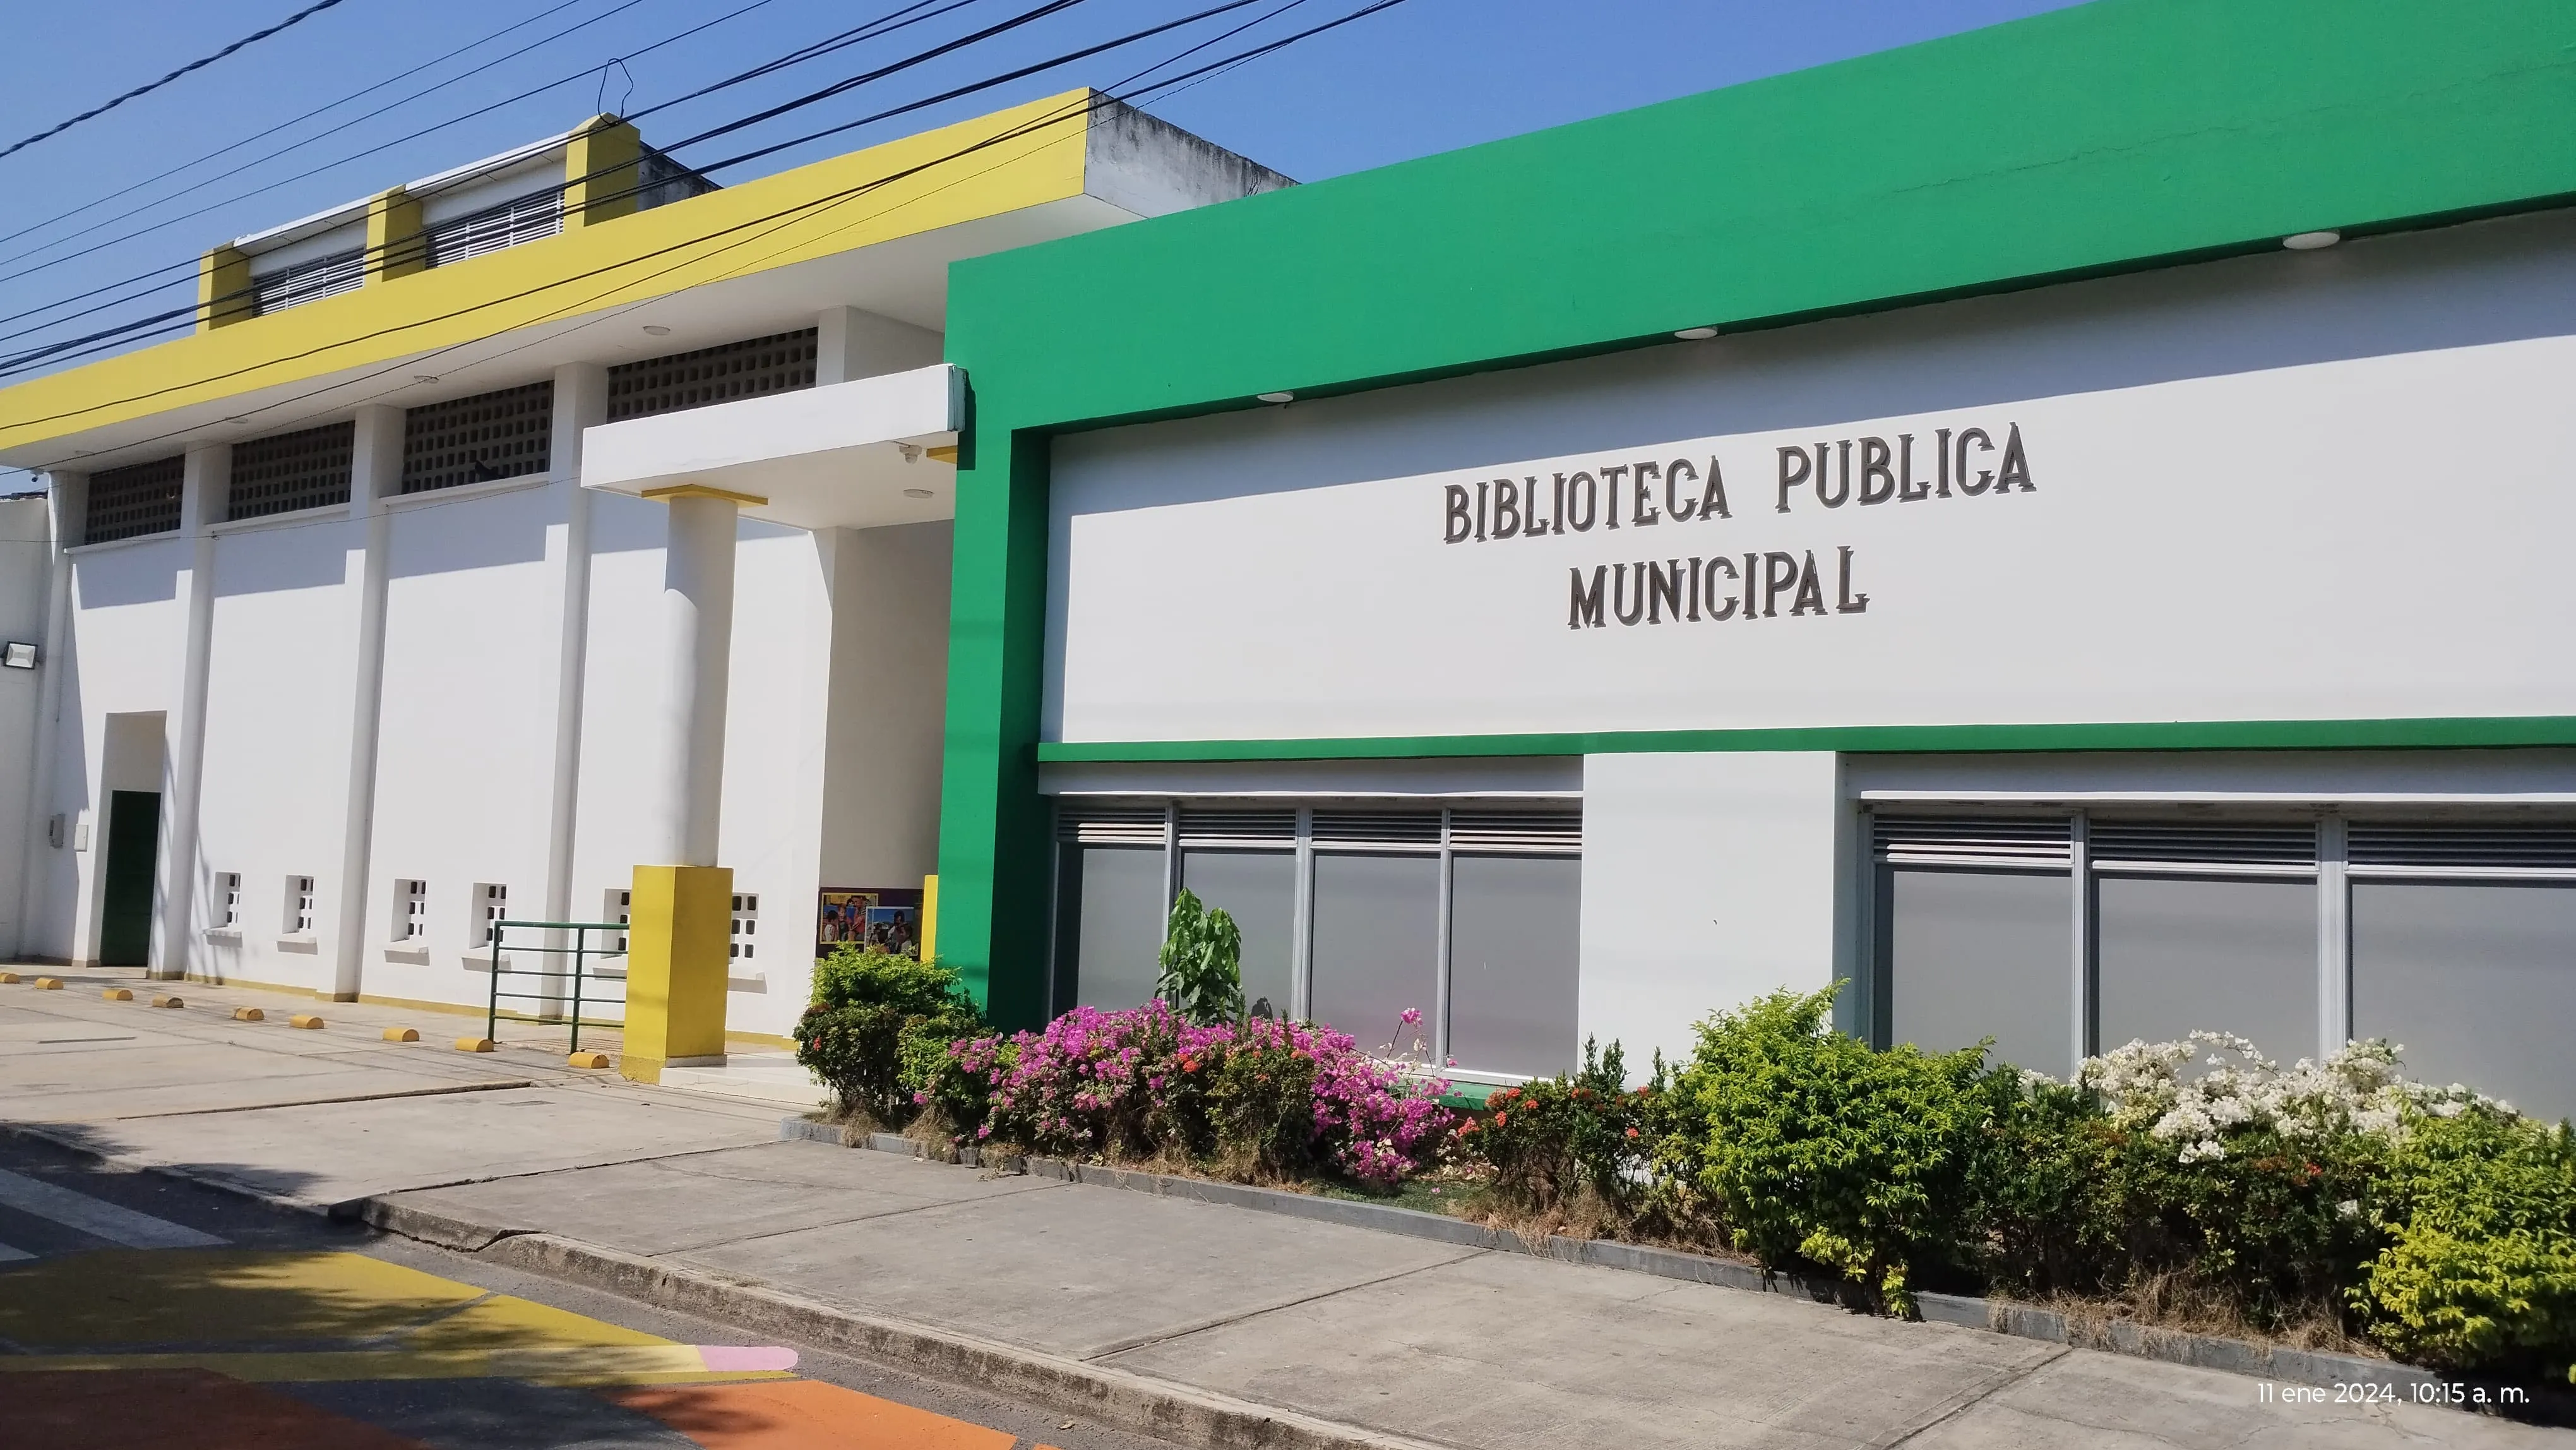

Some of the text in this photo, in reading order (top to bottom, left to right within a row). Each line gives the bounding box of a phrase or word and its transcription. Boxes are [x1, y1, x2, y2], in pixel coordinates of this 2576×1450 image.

[1443, 421, 2037, 544] BIBLIOTECA PUBLICA
[1567, 545, 1871, 630] MUNICIPAL
